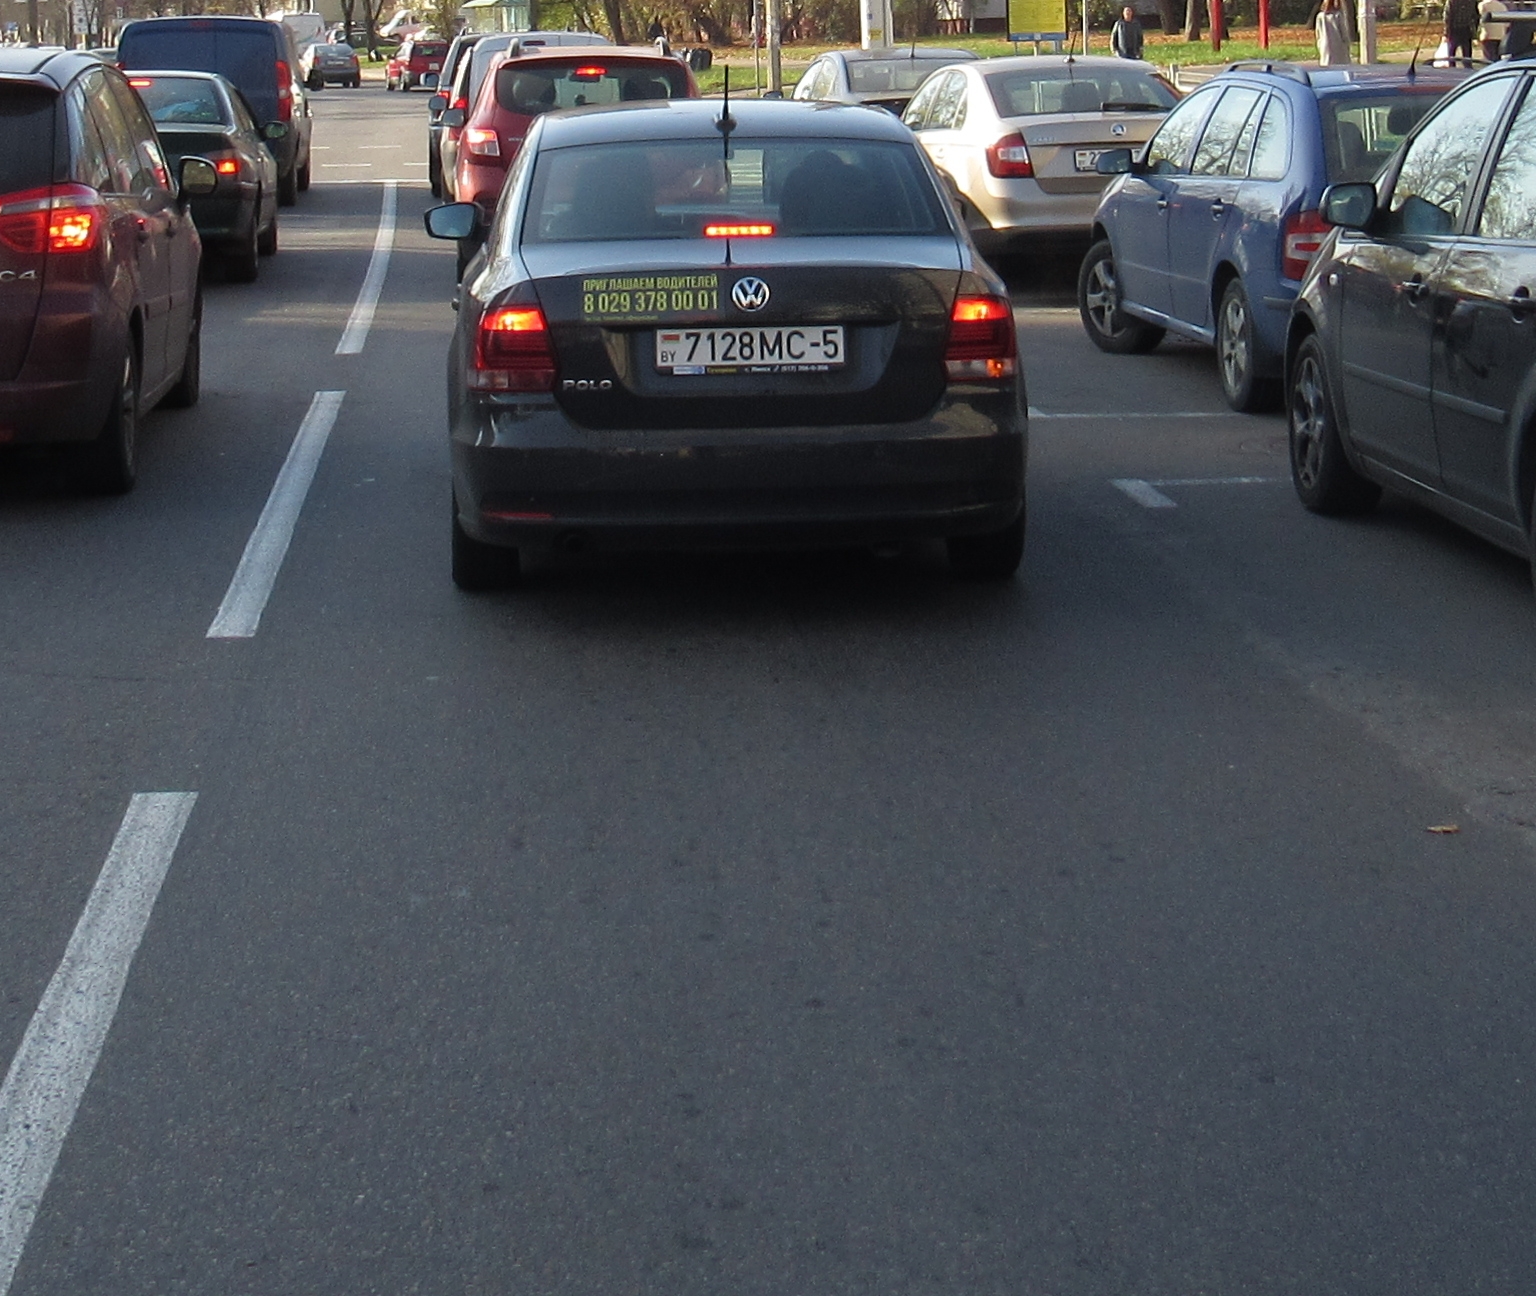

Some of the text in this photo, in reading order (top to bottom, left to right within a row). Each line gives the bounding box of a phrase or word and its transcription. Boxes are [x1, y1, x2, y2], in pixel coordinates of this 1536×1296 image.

[583, 273, 718, 292] ПРИГЛАШАЕМ ВОДИТЕЛЕЙ
[584, 289, 719, 314] 8 029 378 00 01
[660, 350, 676, 363] BY
[563, 379, 613, 392] POLO
